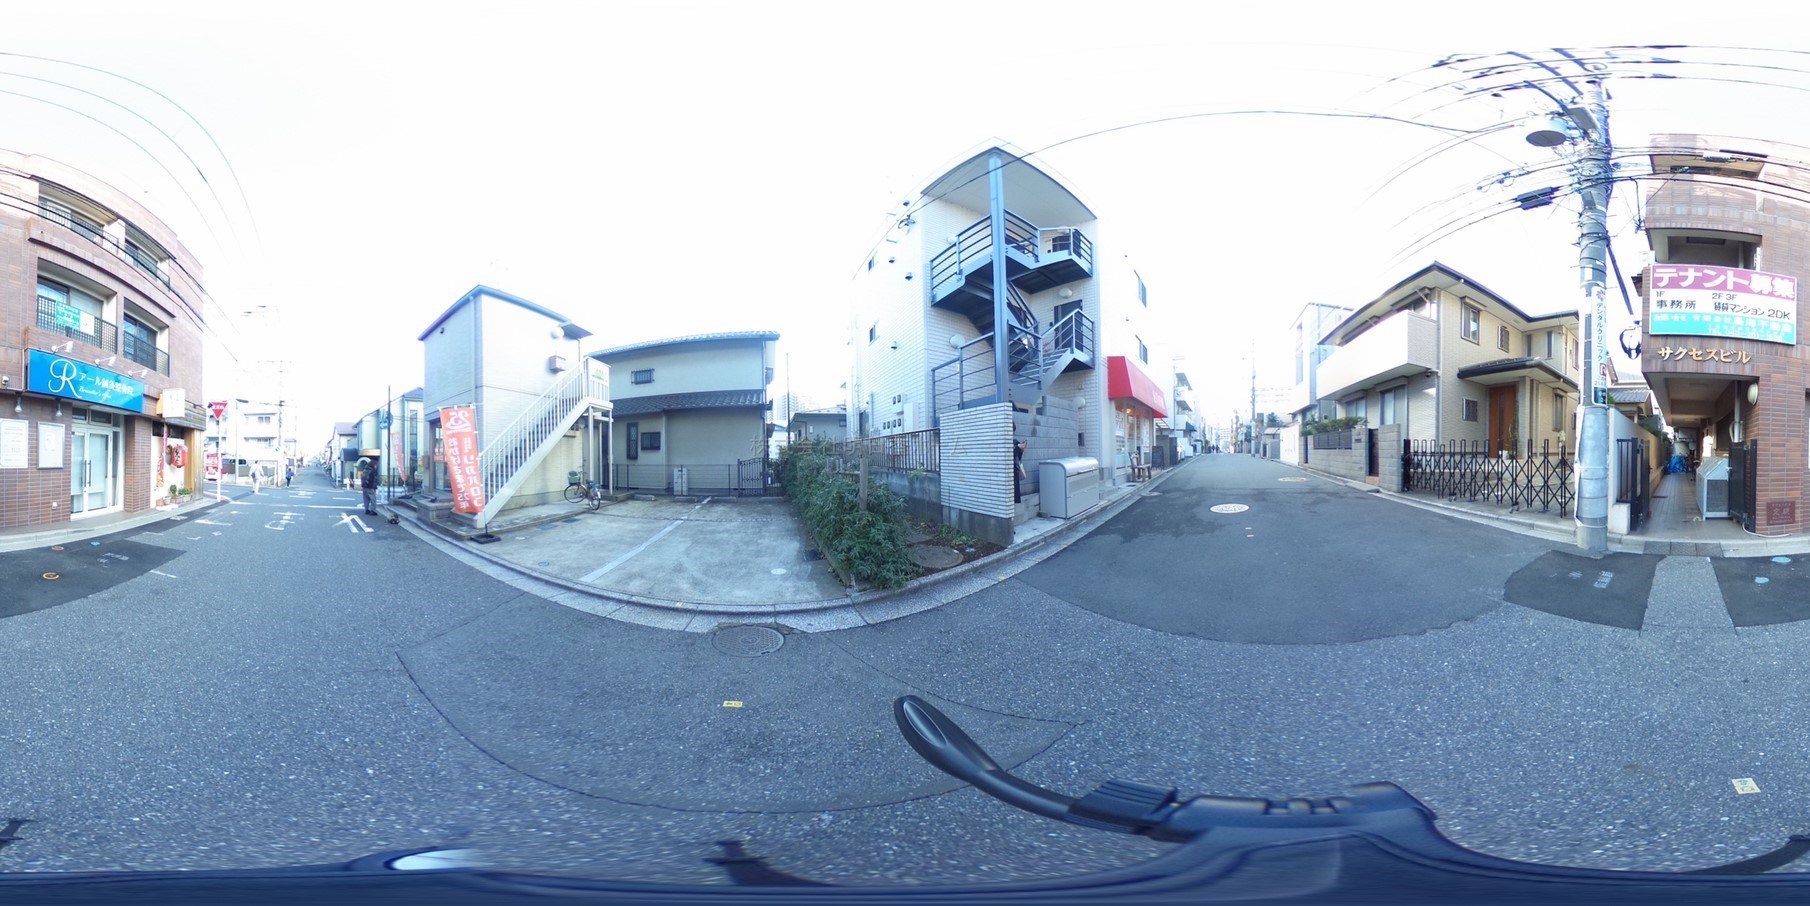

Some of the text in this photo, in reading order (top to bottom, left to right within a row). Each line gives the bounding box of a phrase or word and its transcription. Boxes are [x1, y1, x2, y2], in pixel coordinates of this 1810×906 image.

[1653, 266, 1795, 299] テナント募集
[1656, 290, 1666, 298] 1F
[1712, 292, 1738, 301] 2F 3F
[1656, 299, 1696, 310] 事務所
[1713, 302, 1791, 320] 賃貸マンション 2DK
[1657, 346, 1752, 364] サクセスビル
